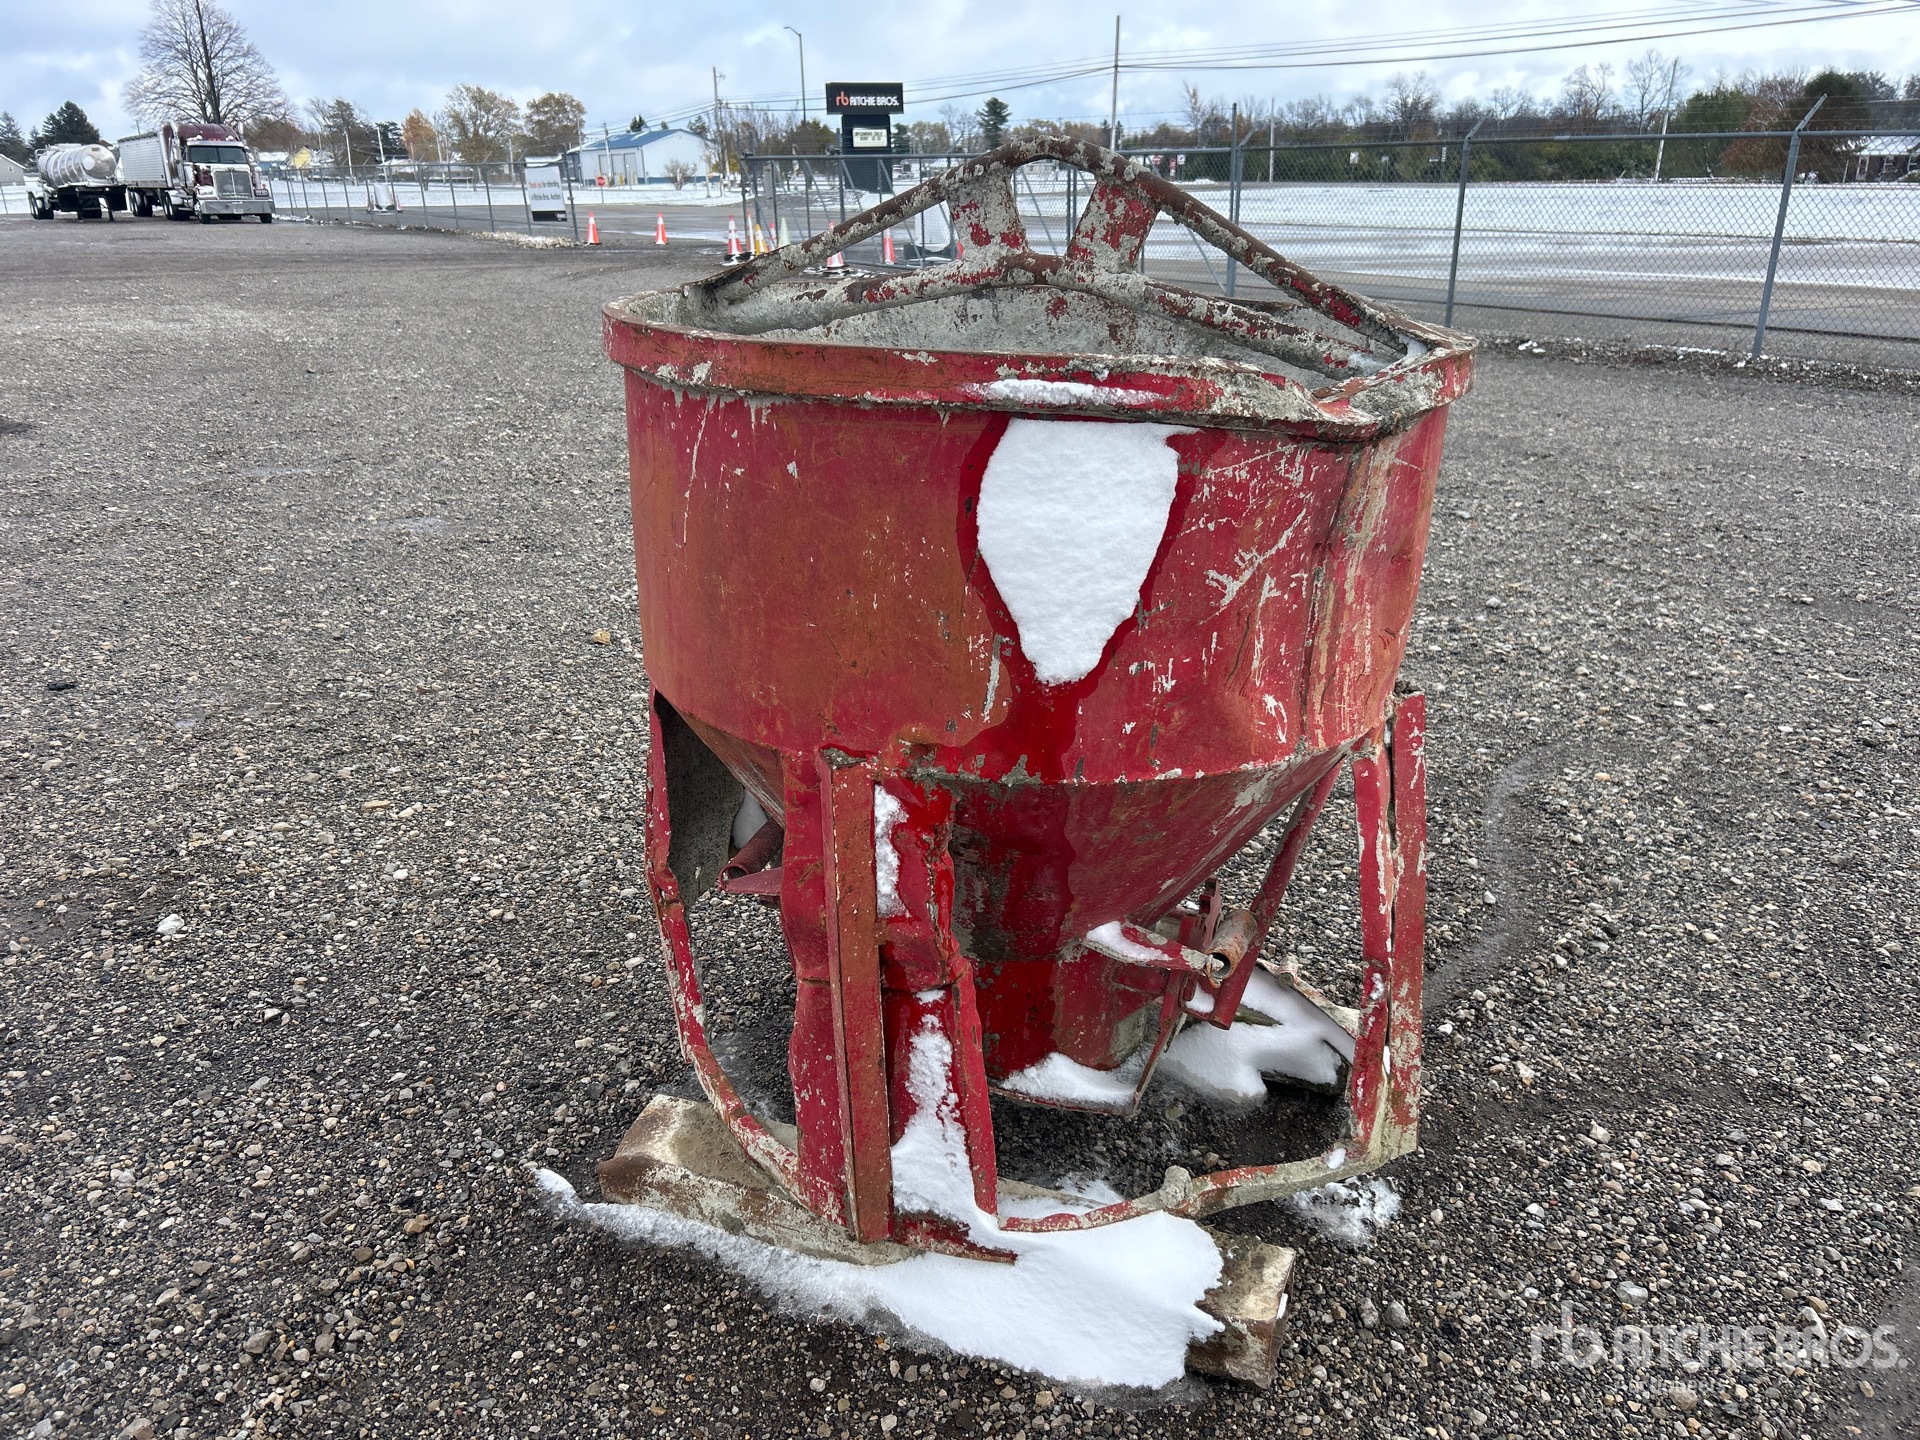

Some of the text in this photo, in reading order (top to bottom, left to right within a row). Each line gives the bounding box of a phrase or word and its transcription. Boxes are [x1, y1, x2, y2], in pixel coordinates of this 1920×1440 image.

[836, 91, 900, 106] rb RITCHIE BROS.
